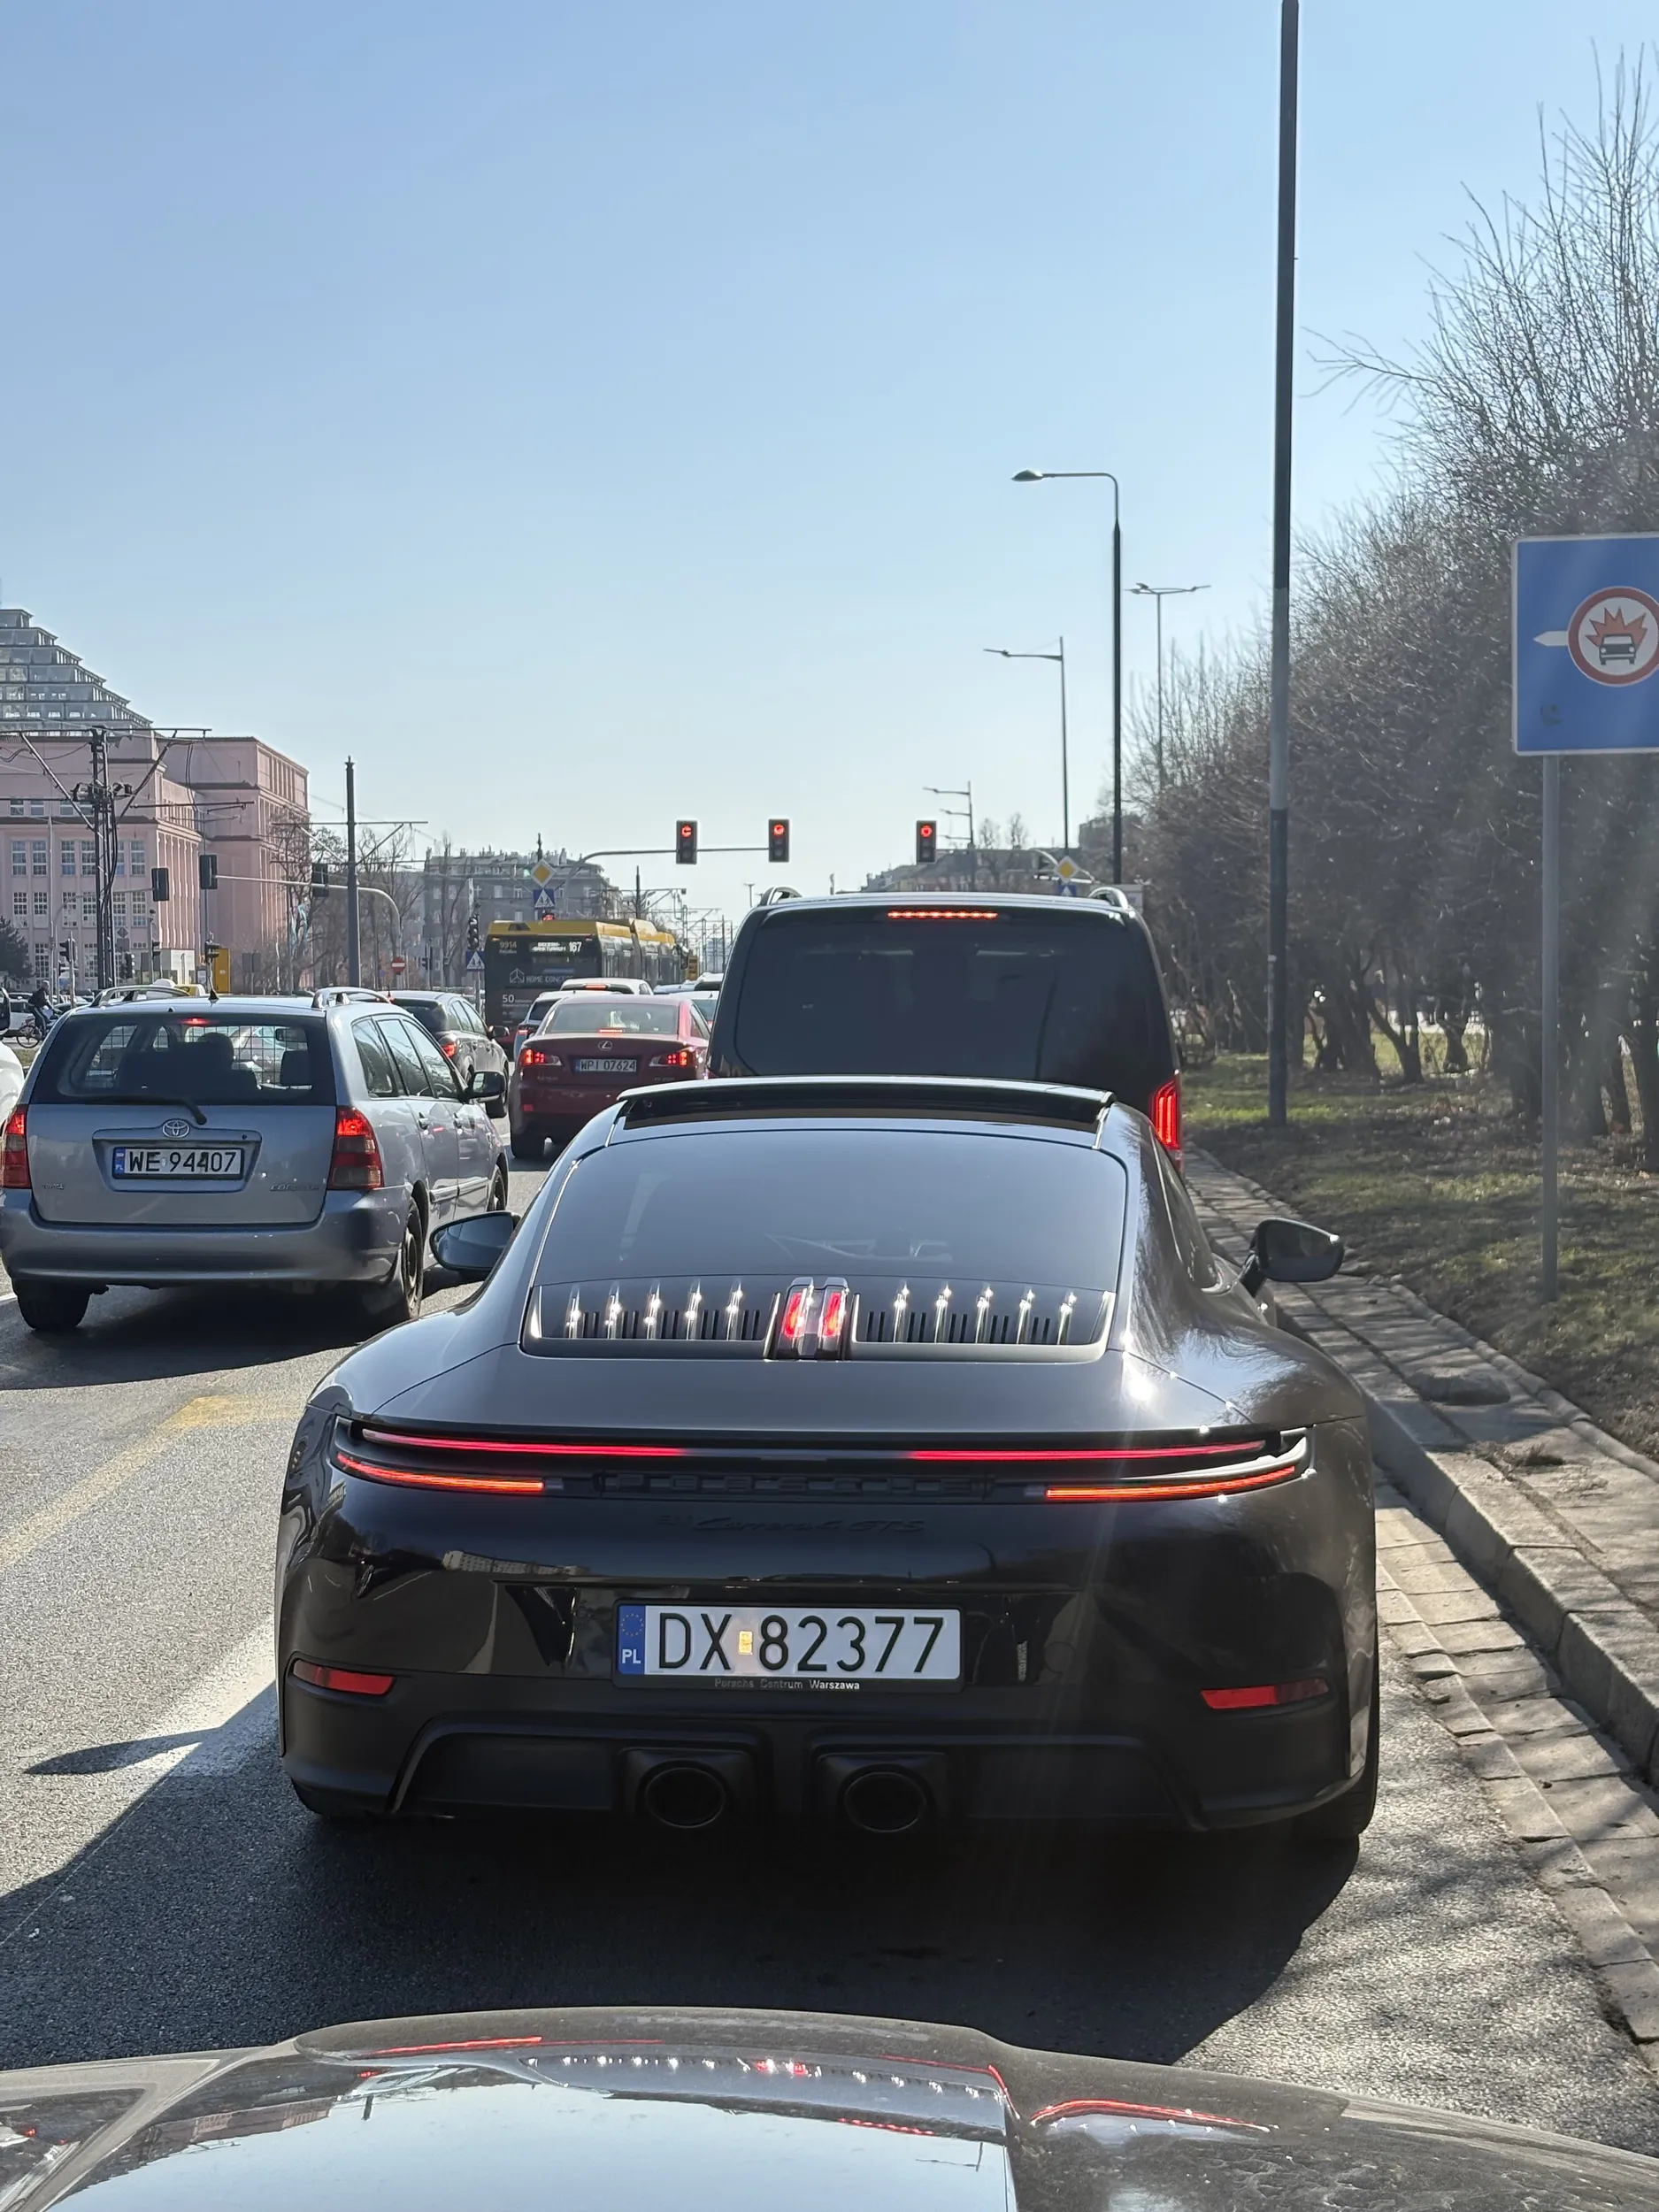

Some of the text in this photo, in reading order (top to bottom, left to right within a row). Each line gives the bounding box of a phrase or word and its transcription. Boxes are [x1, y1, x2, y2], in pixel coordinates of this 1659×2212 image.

[568, 941, 582, 953] 167
[526, 975, 573, 984] HOME CONCE
[502, 994, 515, 1003] 50
[580, 1060, 635, 1071] WPI 07624
[129, 1151, 237, 1173] WE 94407
[845, 1519, 926, 1532] GTS
[658, 1611, 945, 1674] DX 82377
[622, 1648, 641, 1664] PL
[760, 1678, 804, 1690] Centrum
[809, 1679, 860, 1691] Warszawa
